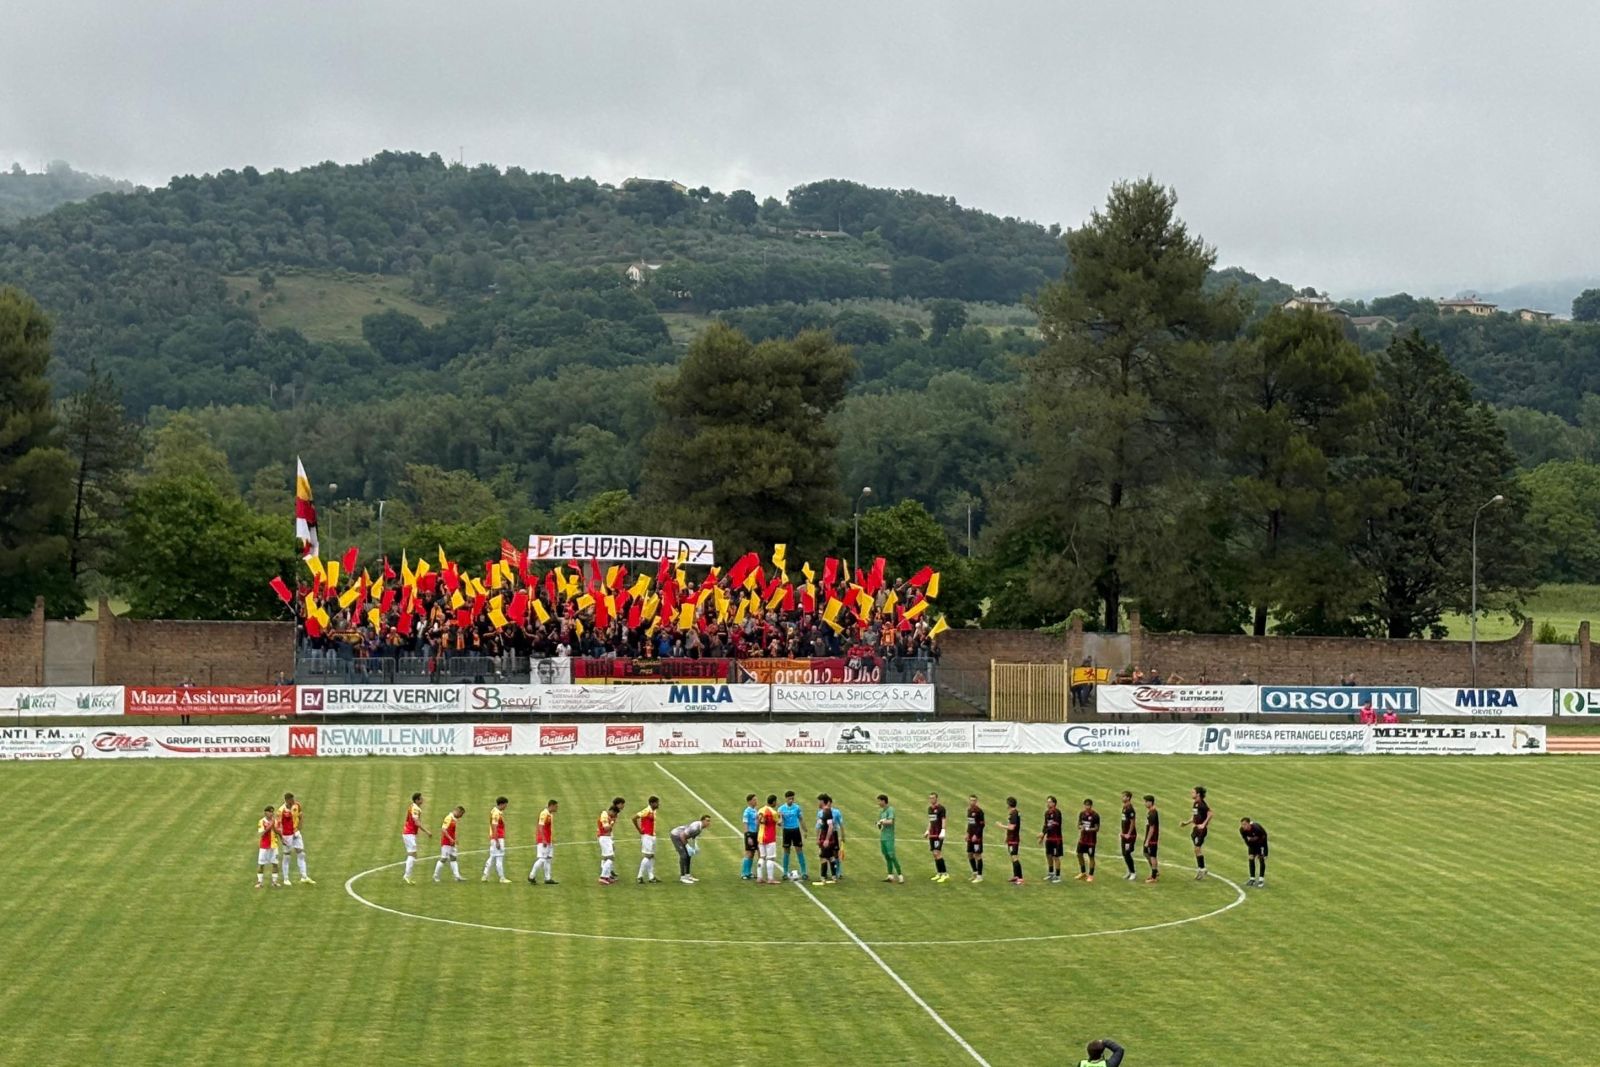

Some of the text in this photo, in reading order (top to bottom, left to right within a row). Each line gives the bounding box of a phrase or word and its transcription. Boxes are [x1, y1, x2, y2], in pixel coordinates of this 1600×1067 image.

[131, 689, 282, 705] Mazzi Assicurazioni
[327, 688, 460, 703] BRUZZI VERNICI
[668, 685, 733, 703] MIRA
[777, 688, 826, 700] BASALTO
[830, 688, 844, 700] LA
[847, 688, 889, 700] SPICCA
[1455, 690, 1518, 707] MIRA
[32, 697, 56, 708] Ricci
[91, 697, 117, 708] Ricci
[1265, 691, 1414, 710] ORSOLINI
[0, 729, 28, 739] NTI
[35, 729, 65, 739] F.M.
[1063, 726, 1130, 748] Ceprini
[1233, 730, 1364, 740] IMPRESA PETRANGELI CESARE
[1372, 728, 1506, 739] METTLE s.r.l.
[166, 736, 271, 744] GRUPPI ELETTROGENI
[658, 738, 699, 748] Marini
[722, 738, 763, 748] Marini
[785, 738, 826, 748] Marini
[1078, 735, 1140, 752] Costruzioni
